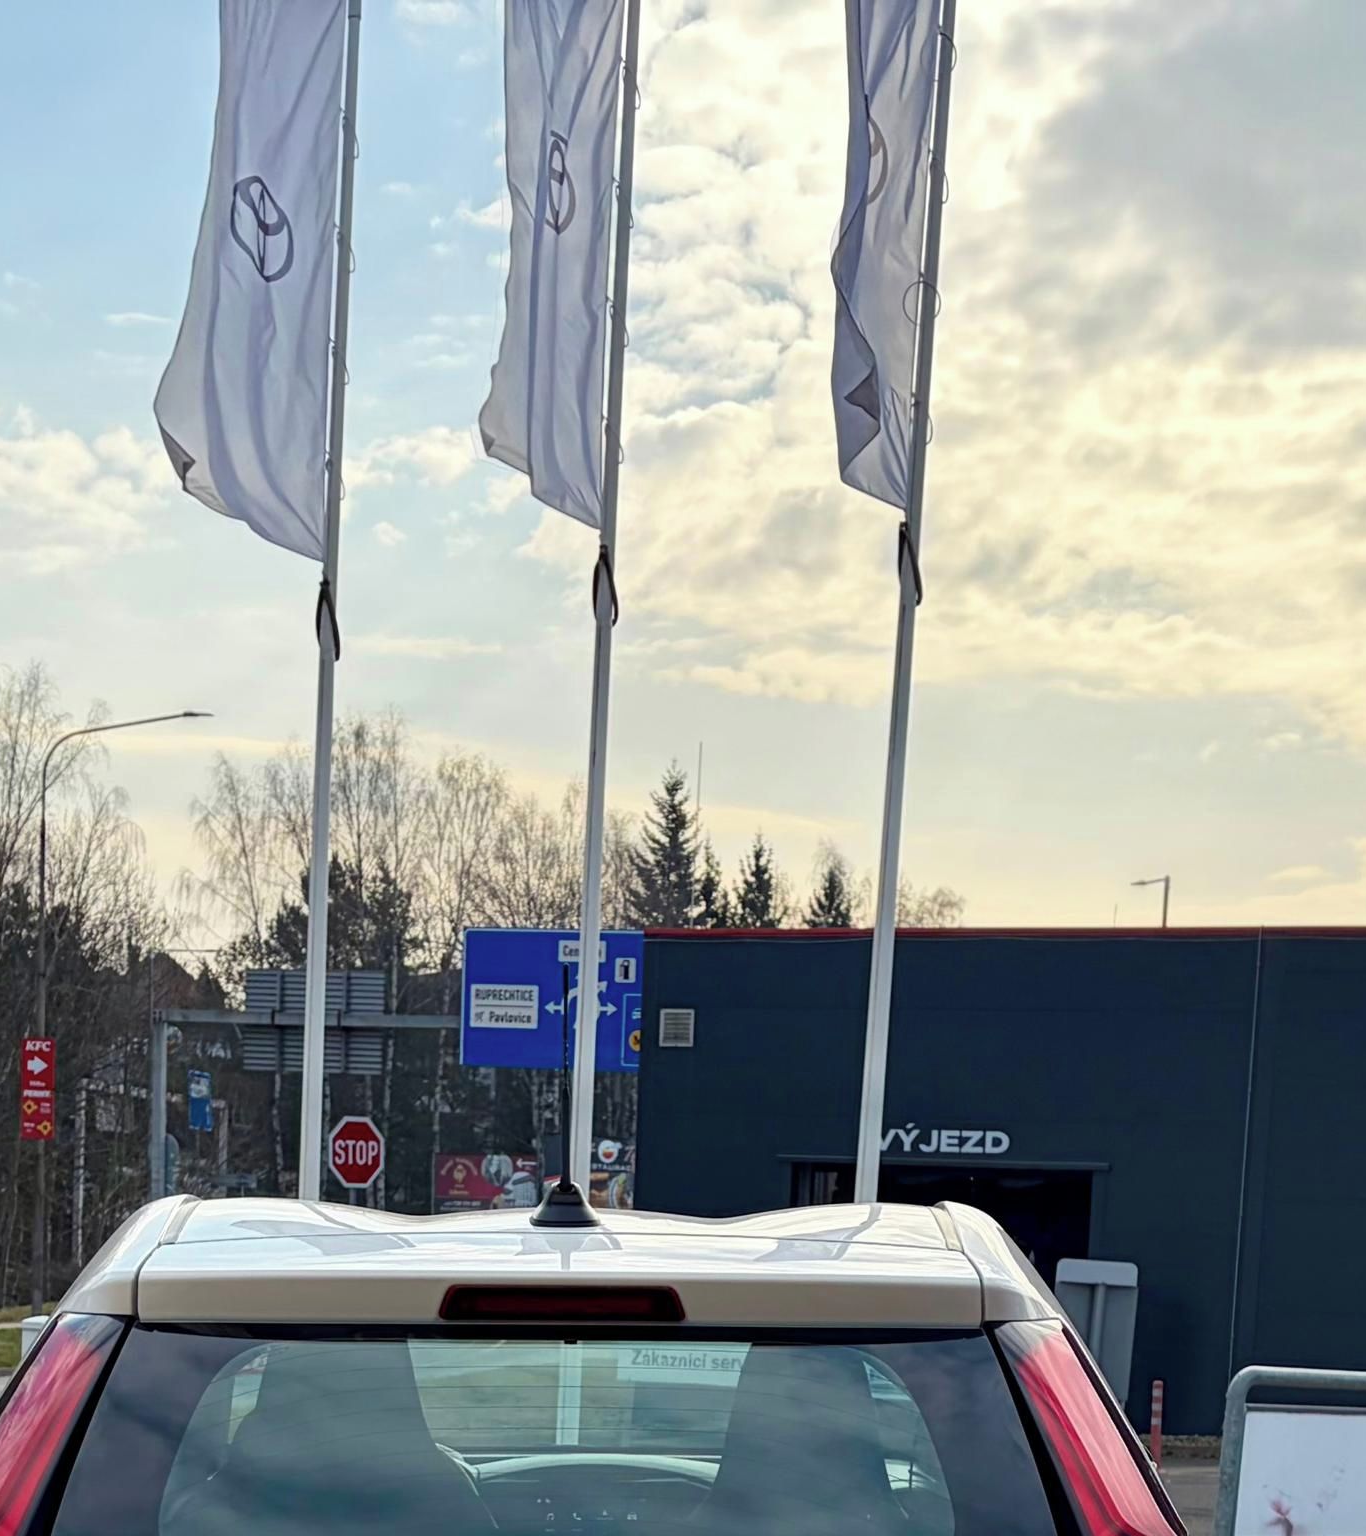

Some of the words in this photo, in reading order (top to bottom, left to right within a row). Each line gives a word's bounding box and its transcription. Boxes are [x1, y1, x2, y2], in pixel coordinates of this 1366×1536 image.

[489, 1010, 532, 1024] Pavlovice
[25, 1041, 52, 1052] KFC
[334, 1139, 379, 1166] STOP
